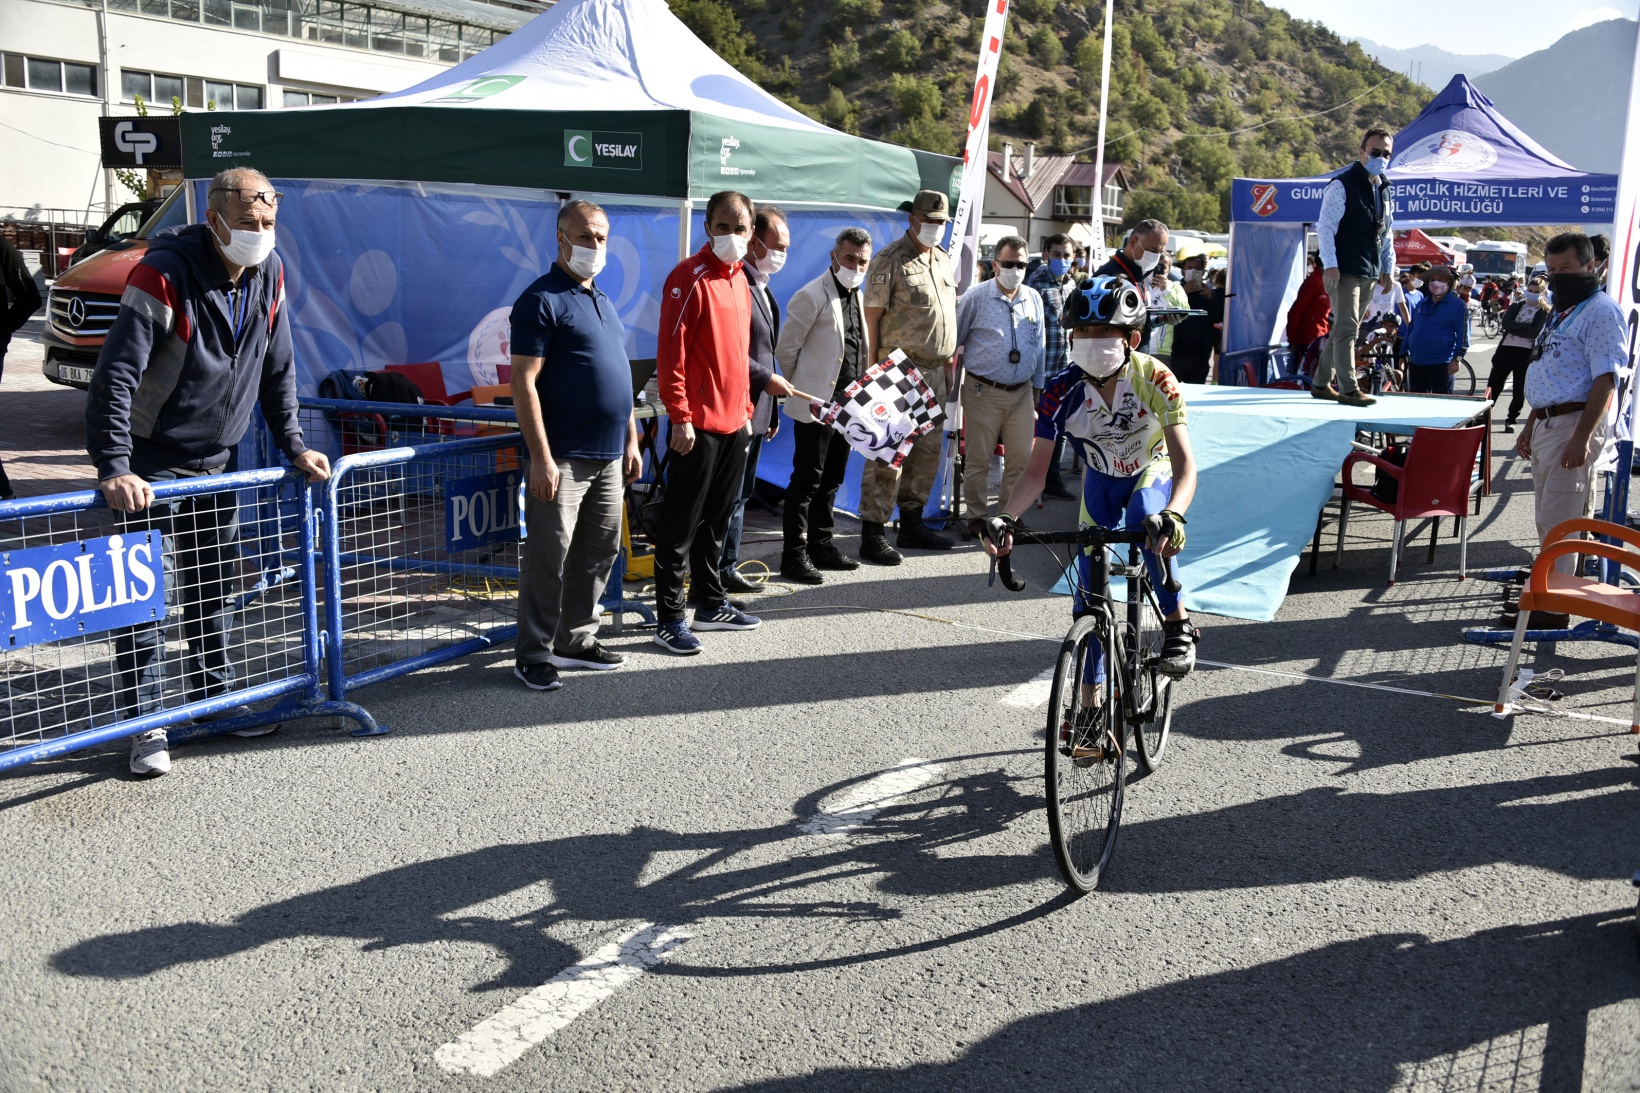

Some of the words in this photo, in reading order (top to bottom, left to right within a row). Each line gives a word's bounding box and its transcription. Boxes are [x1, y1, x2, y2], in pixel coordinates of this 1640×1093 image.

[1454, 182, 1543, 198] HİZMETLERİ
[1547, 186, 1568, 198] VE
[1408, 197, 1503, 214] MÜDÜRLÜĞÜ
[6, 534, 156, 631] POLİS
